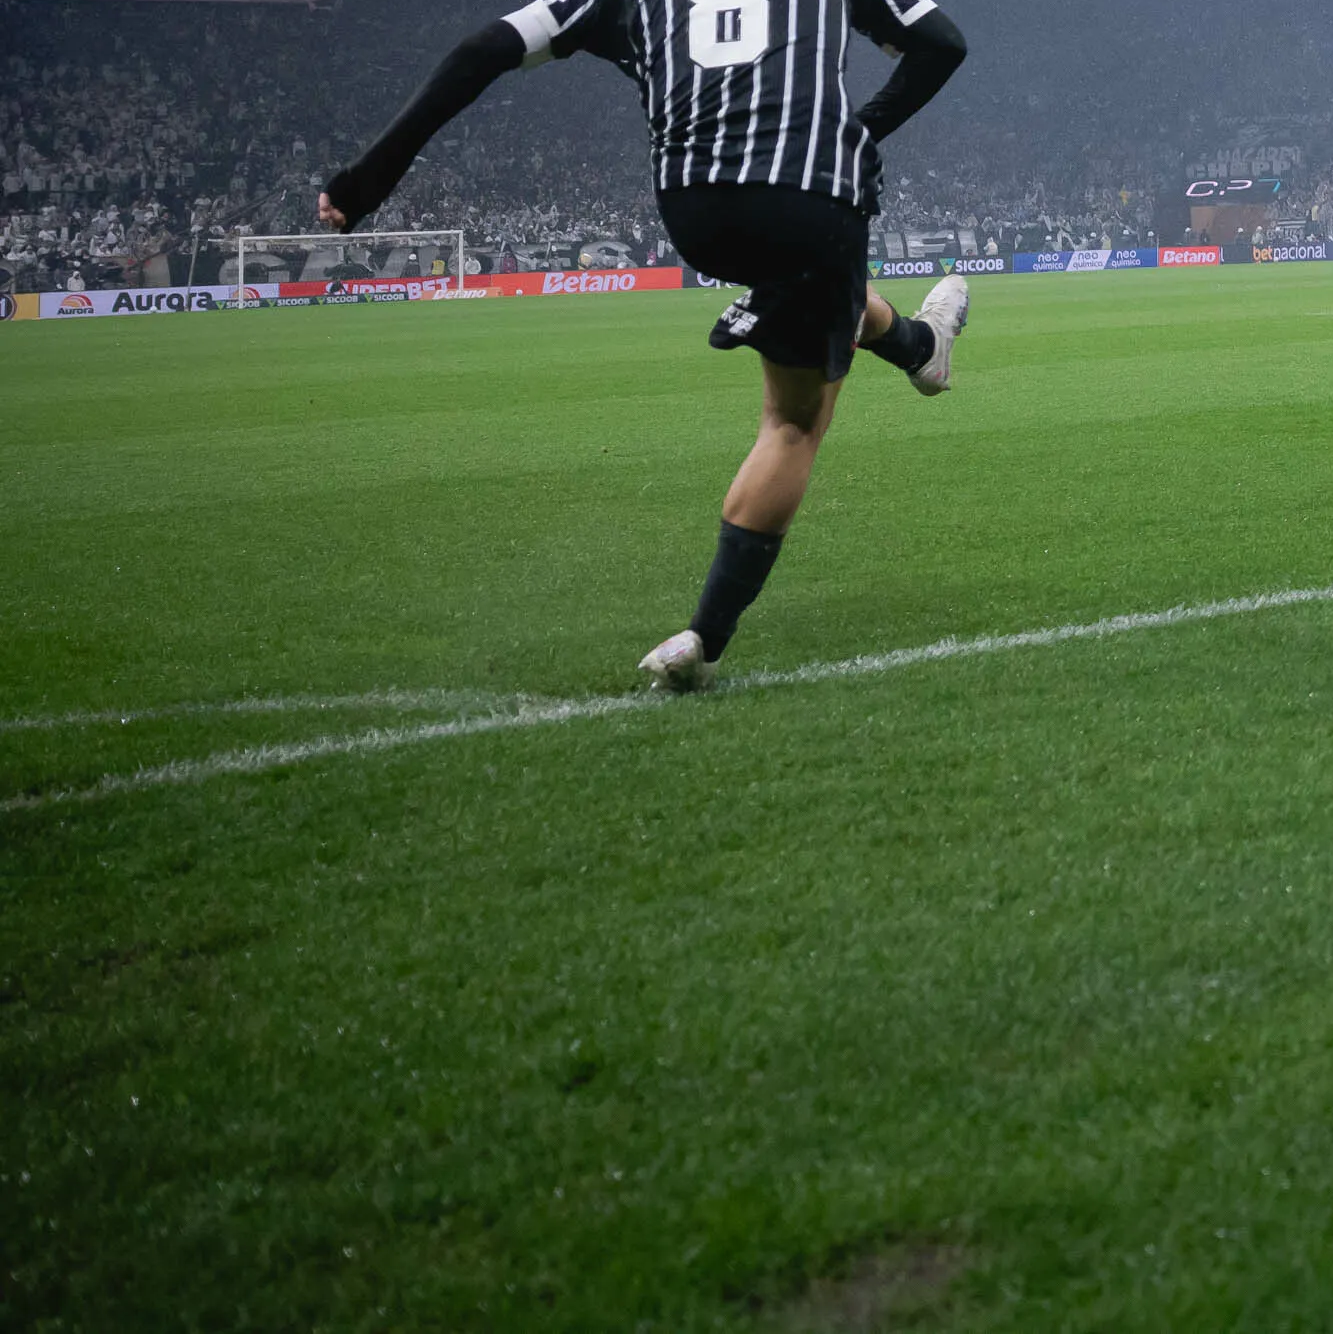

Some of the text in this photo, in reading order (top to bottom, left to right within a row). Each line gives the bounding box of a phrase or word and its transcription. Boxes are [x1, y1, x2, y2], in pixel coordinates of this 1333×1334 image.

[1037, 253, 1060, 263] neo
[1077, 251, 1099, 262] neo
[1115, 249, 1137, 260] neo
[1163, 249, 1216, 265] Betano
[882, 261, 934, 276] SICOOB
[955, 258, 1004, 273] SICOOB
[542, 272, 637, 294] Betano
[112, 290, 215, 314] Aurora
[57, 306, 95, 316] Aurora
